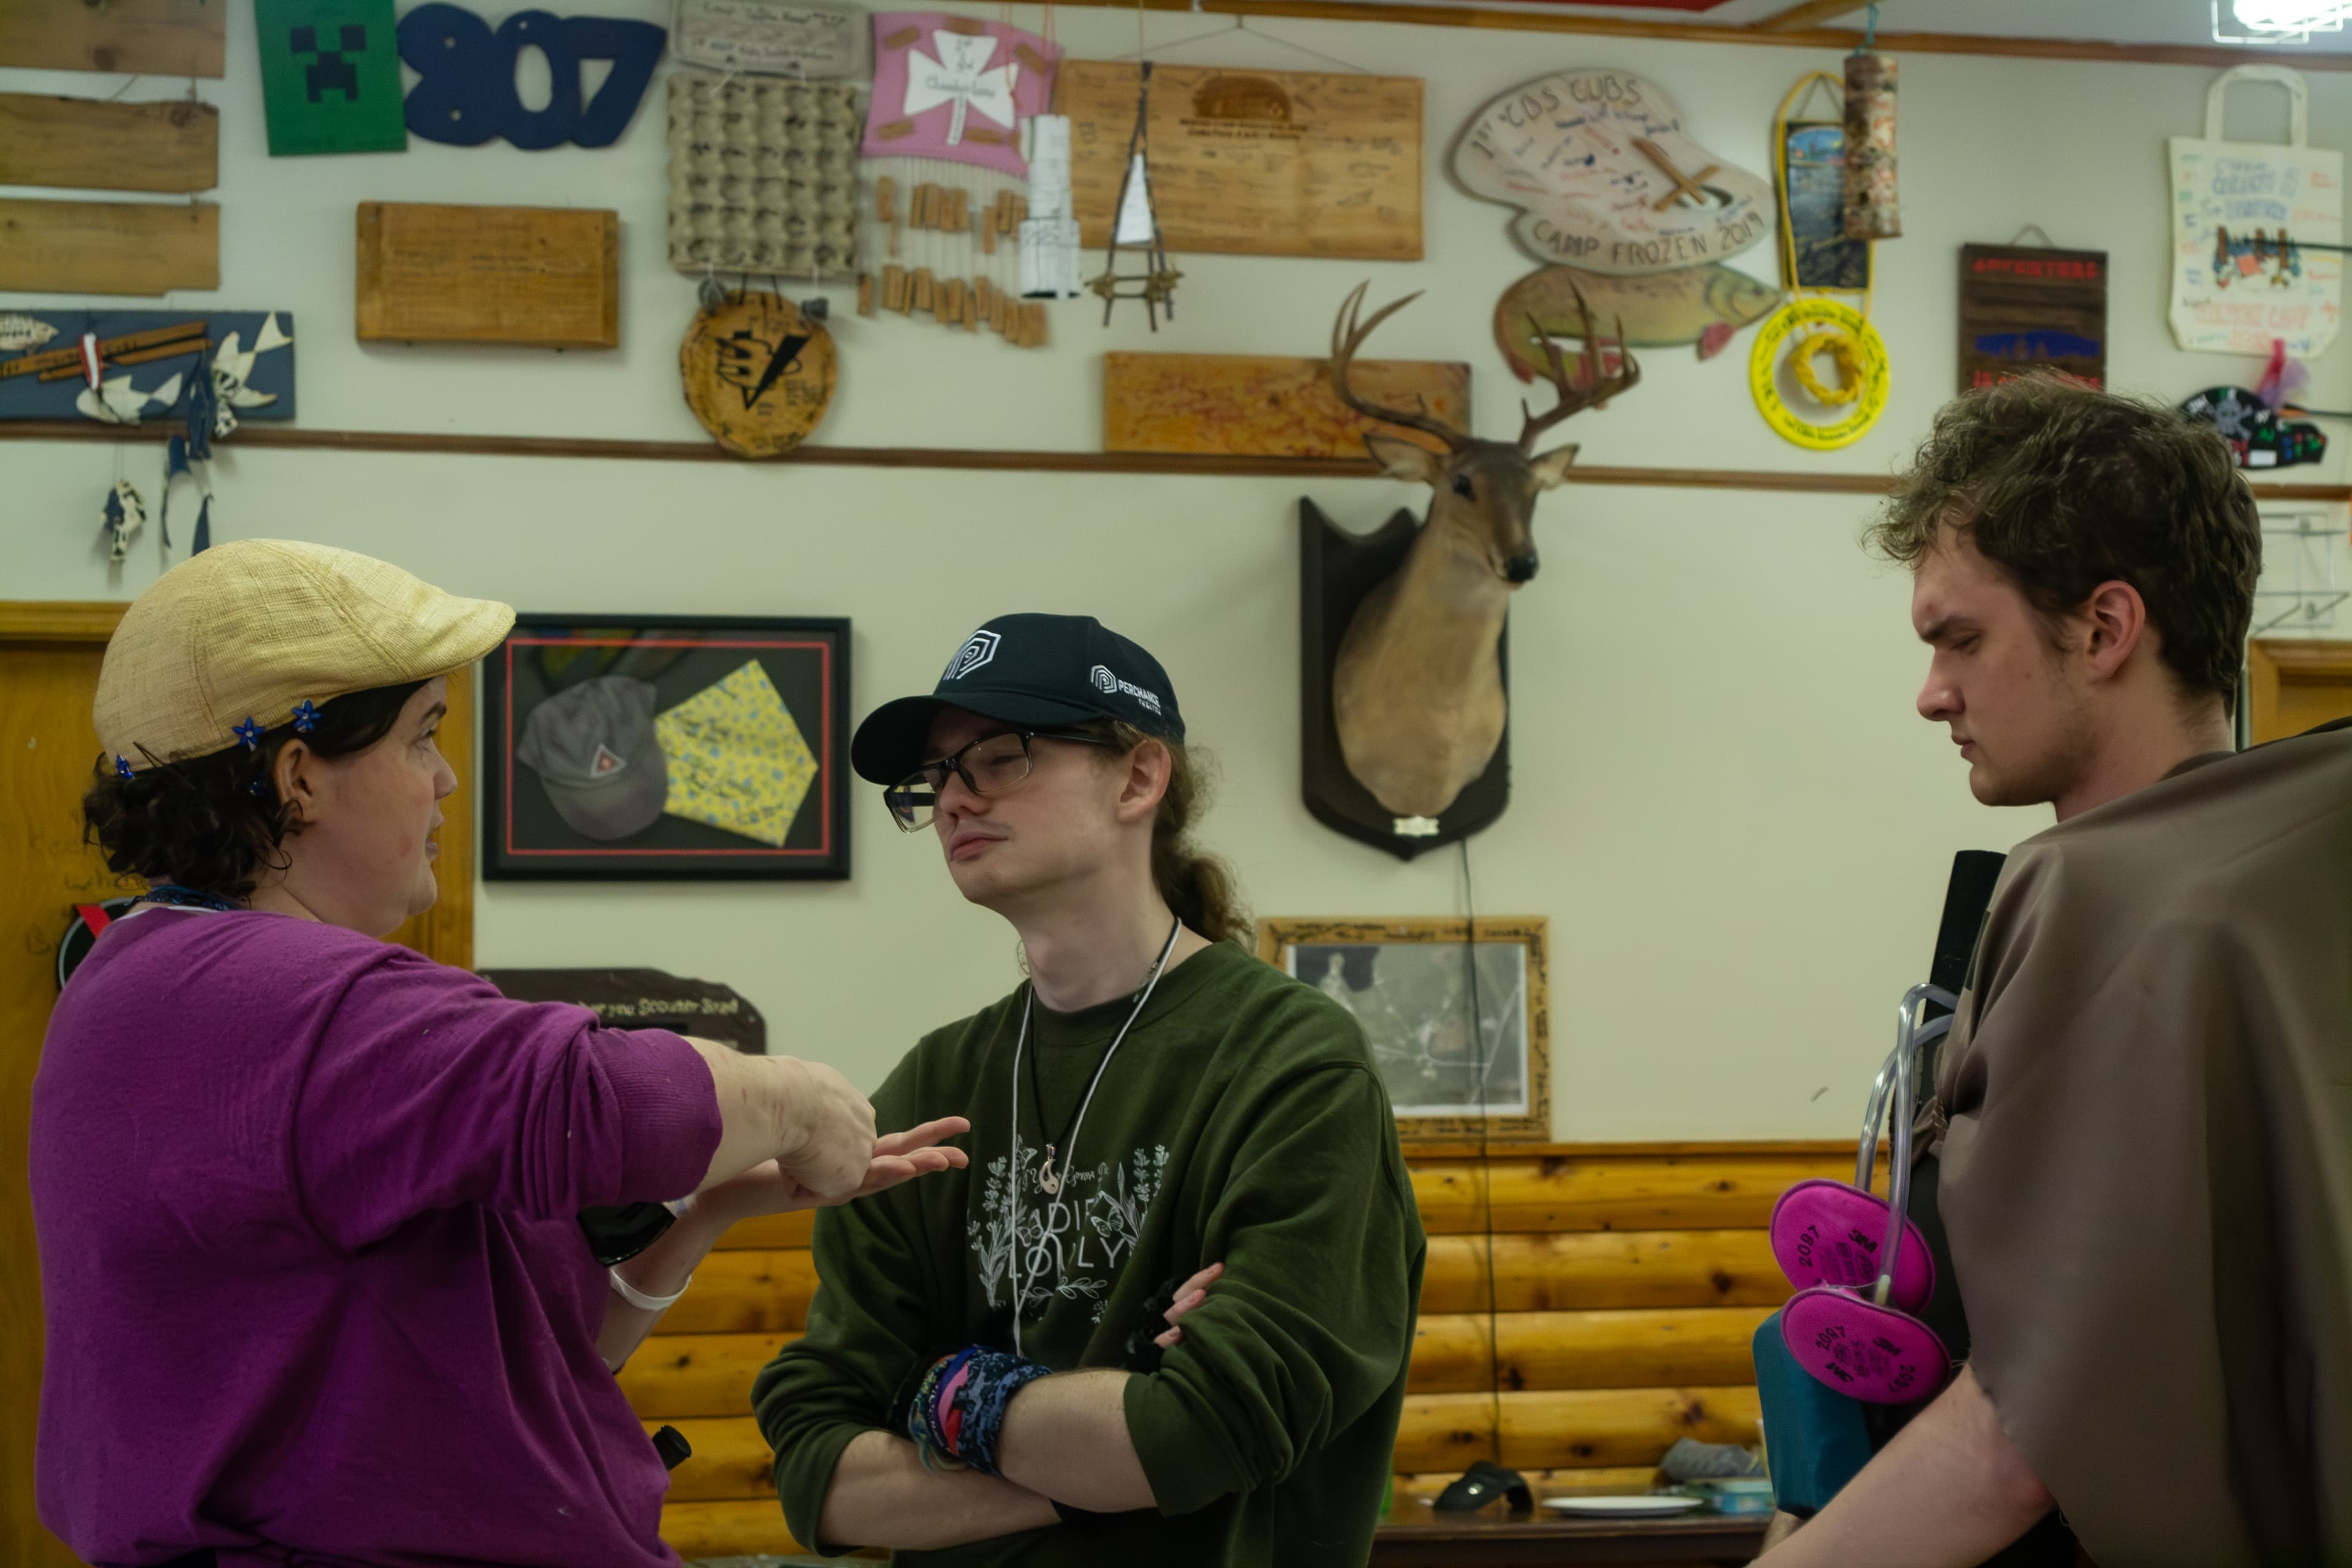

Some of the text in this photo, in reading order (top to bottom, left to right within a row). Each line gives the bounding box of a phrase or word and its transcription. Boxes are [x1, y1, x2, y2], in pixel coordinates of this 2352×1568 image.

[1569, 75, 1642, 105] CUBS
[1531, 211, 1764, 266] CAMP FROZEN 2019
[1118, 679, 1161, 707] PERCHANCE
[1797, 1224, 1879, 1268] 2097 3M
[1815, 1325, 1845, 1351] 2097
[1872, 1336, 1902, 1356] 3M
